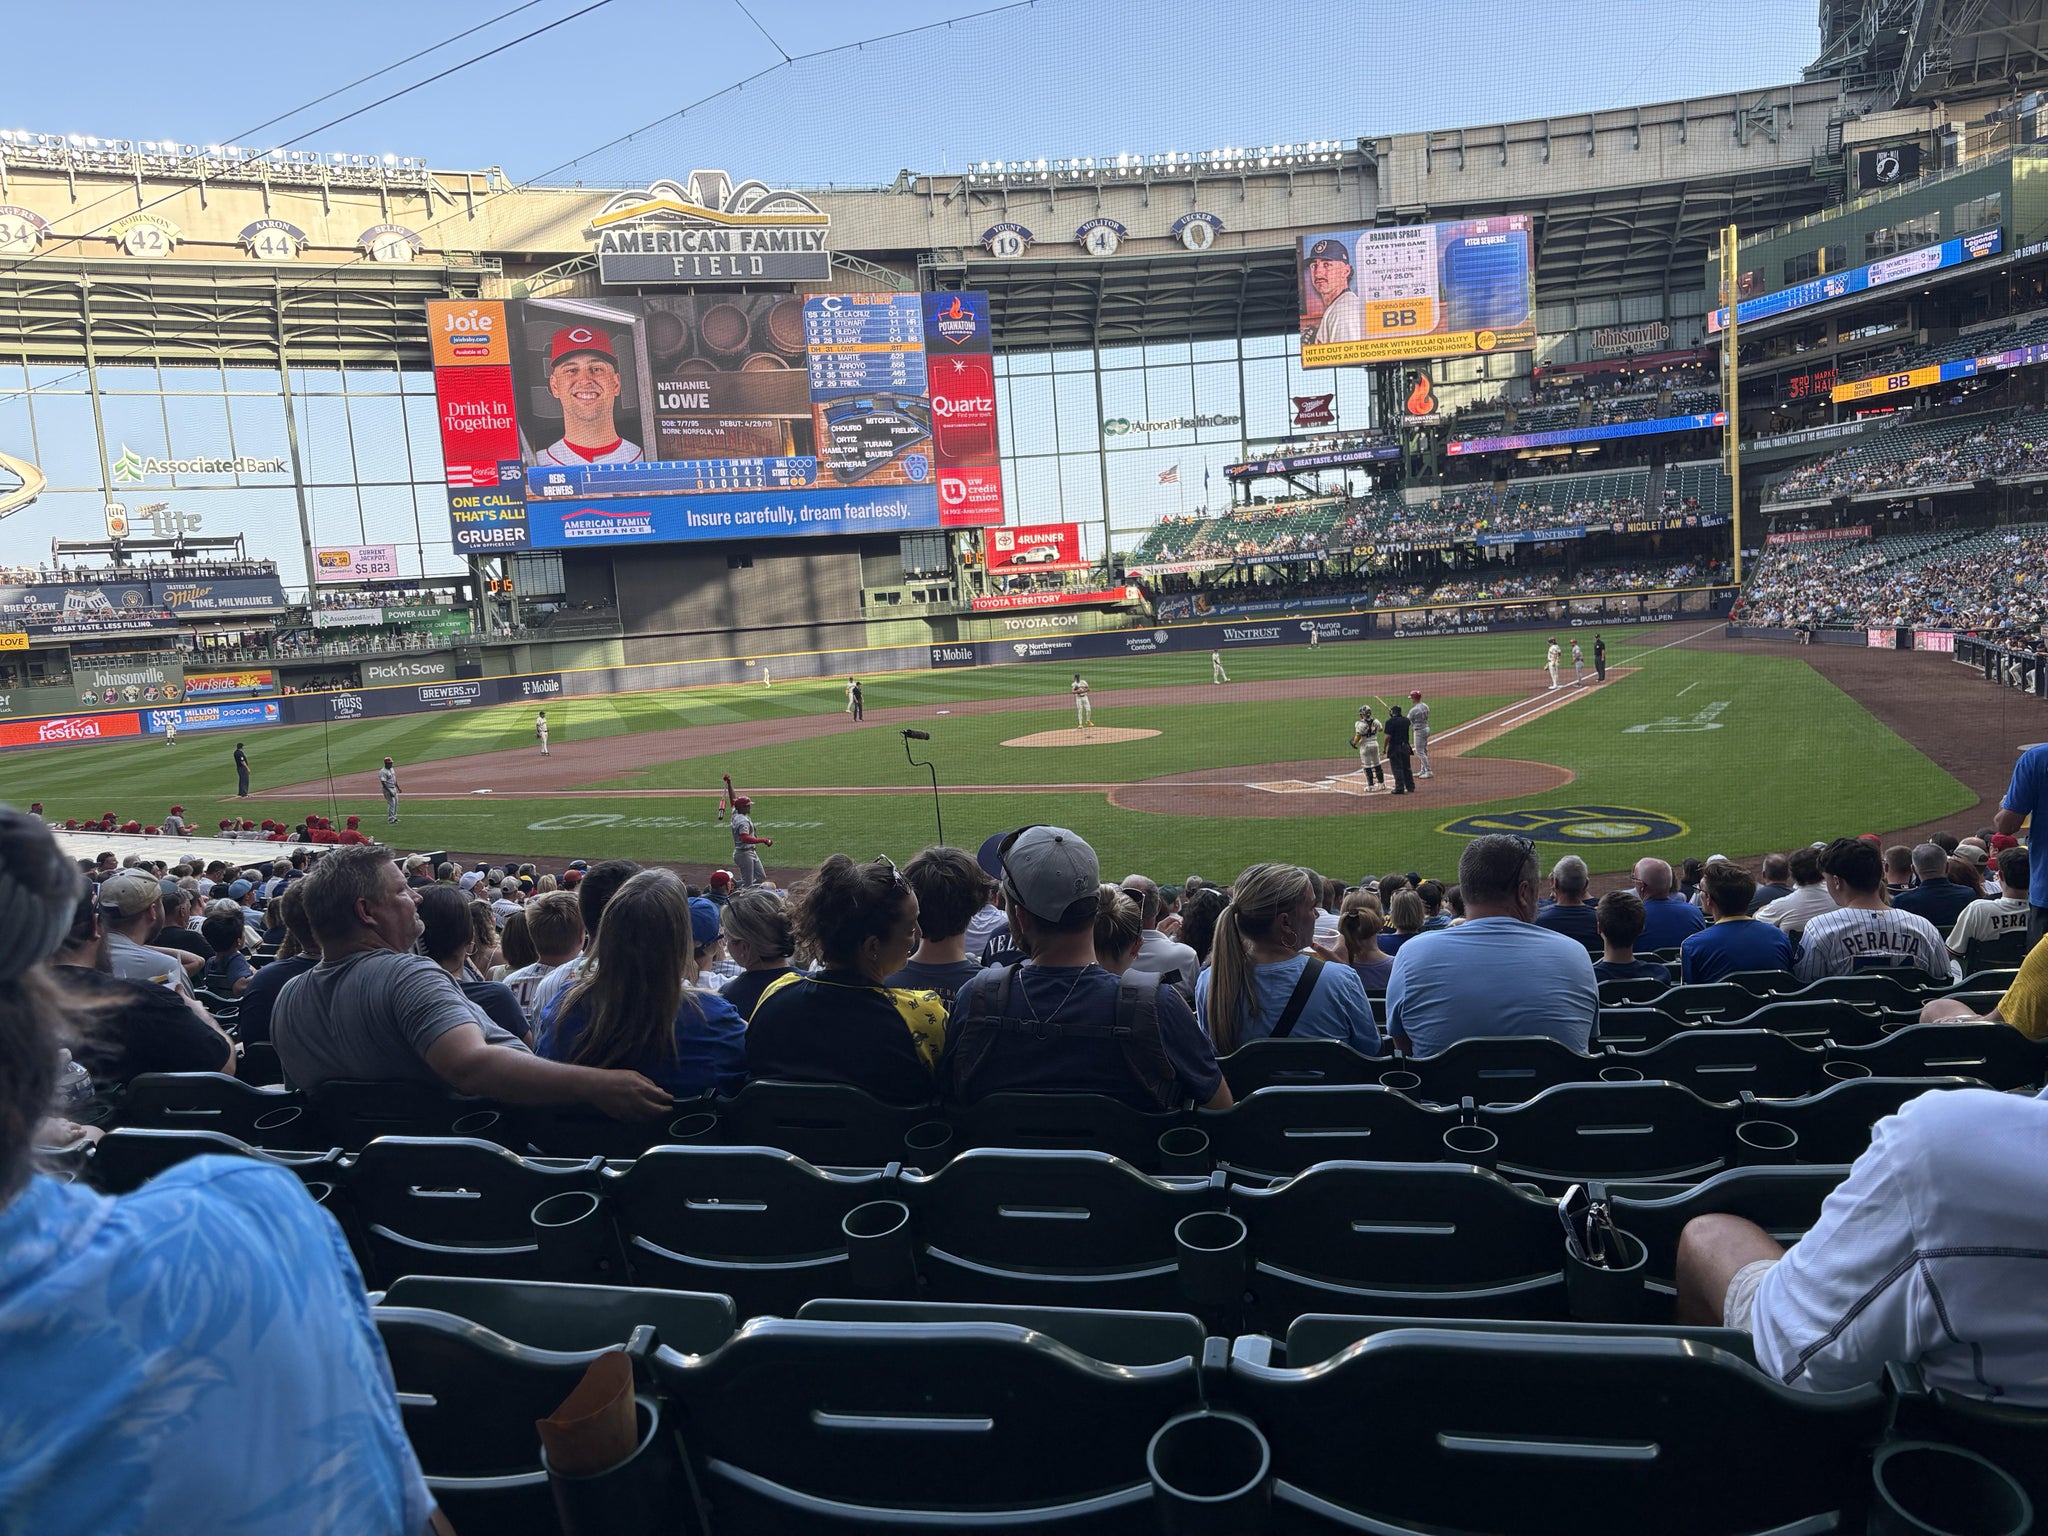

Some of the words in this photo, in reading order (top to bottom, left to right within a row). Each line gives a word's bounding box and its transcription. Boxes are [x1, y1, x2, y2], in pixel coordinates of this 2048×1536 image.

[119, 213, 172, 229] ROBINSON
[1181, 212, 1213, 223] UECKER
[256, 221, 290, 232] AARON
[374, 225, 405, 235] SELIG
[993, 224, 1021, 234] YOUNT
[1082, 219, 1120, 232] MOLITOR
[131, 230, 163, 250] 42
[1095, 232, 1106, 249] 4
[1370, 231, 1397, 241] BRANDON
[1398, 229, 1421, 239] SPROAT
[1464, 238, 1480, 246] PITCH
[1481, 235, 1507, 245] SEQUENCE
[1964, 233, 1998, 248] Legends
[260, 235, 289, 254] 44
[601, 231, 731, 254] AMERICAN
[741, 230, 826, 252] FAMILY
[997, 237, 1019, 254] 19
[1969, 242, 1992, 252] Game
[673, 255, 764, 277] FIELD
[444, 310, 493, 331] Joie
[1382, 309, 1417, 328] BB
[938, 321, 976, 332] POTAWATOMI
[1411, 338, 1436, 346] PELLA!
[1436, 335, 1468, 345] QUALITY
[1592, 322, 1669, 349] Johnsonville
[1305, 354, 1342, 363] WINDOWS
[1360, 351, 1385, 359] DOORS
[1387, 348, 1402, 356] FOR
[1403, 345, 1444, 355] WISCONSIN
[1445, 342, 1474, 351] HOMES.
[1604, 344, 1631, 354] PARTY
[1633, 342, 1656, 350] DECK
[1814, 369, 1839, 380] MARKET
[657, 381, 710, 391] NATHANIEL
[1887, 374, 1910, 390] BB
[659, 393, 710, 409] LOWE
[932, 395, 993, 417] Quartz
[447, 400, 492, 417] Drink
[494, 400, 508, 414] in
[444, 415, 513, 433] Together
[1131, 420, 1170, 434] Aurora
[1173, 416, 1211, 430] Health
[1213, 413, 1241, 426] Care
[836, 436, 857, 444] ORTIZ
[864, 440, 893, 448] TURANG
[865, 450, 893, 458] BAUERS
[1293, 458, 1312, 467] GREAT
[1313, 457, 1333, 465] TASTE.
[1333, 455, 1342, 463] 96
[1342, 452, 1374, 461] CALORIES.
[825, 460, 867, 468] CONTRERAS
[501, 471, 522, 481] 250
[549, 473, 566, 484] REDS
[543, 485, 574, 496] BREWERS
[968, 484, 997, 494] credit
[452, 496, 480, 508] ONE
[482, 495, 523, 506] CALL...
[969, 493, 998, 502] union
[107, 508, 125, 517] Lite
[452, 510, 497, 522] THAT'S
[499, 508, 526, 520] ALL!
[687, 509, 731, 527] Insure
[734, 505, 797, 526] carefully,
[800, 505, 842, 523] dream
[844, 501, 911, 521] fearlessly.
[152, 511, 202, 538] Lite
[564, 519, 614, 530] AMERICAN
[617, 517, 651, 527] FAMILY
[1627, 520, 1662, 532] NICOLET
[1665, 518, 1683, 529] LAW
[457, 527, 526, 543] GRUBER
[571, 527, 645, 536] INSURANCE
[1533, 528, 1580, 539] WINTRUST
[1017, 532, 1064, 545] 4RUNNER
[1353, 545, 1375, 556] 620
[1376, 542, 1412, 554] WTMJ
[1413, 543, 1450, 551] BREWERS
[1247, 556, 1264, 564] GREAT
[1289, 552, 1317, 560] CALORIES.
[24, 595, 37, 604] GO
[163, 586, 213, 608] Miller
[191, 598, 218, 609] TIME,
[218, 595, 273, 607] MILWAUKEE
[975, 598, 1010, 609] TOYOTA
[1011, 594, 1061, 606] TERRITORY
[3, 604, 29, 613] BREW
[31, 603, 55, 611] CREW
[388, 609, 416, 619] POWER
[417, 608, 441, 617] ALLEY
[52, 624, 76, 632] GREAT
[77, 623, 103, 631] TASTE.
[103, 622, 121, 630] LESS
[122, 620, 153, 629] FILLING.
[1004, 615, 1079, 630] TOYOTA.COM
[1316, 621, 1341, 630] Aurora
[1583, 618, 1602, 626] Aurora
[1640, 614, 1673, 622] BULLPEN
[1223, 627, 1279, 639] WINTRUST
[1317, 628, 1341, 637] Health
[1342, 628, 1359, 636] Care
[1457, 626, 1488, 634] BULLPEN
[0, 637, 24, 646] LOVE
[1028, 641, 1072, 650] Northwestern
[1126, 637, 1151, 646] Johnson
[1130, 643, 1156, 651] Controls
[942, 648, 973, 661] Mobile
[1029, 648, 1052, 656] Mutual
[368, 665, 398, 679] Pick
[411, 663, 445, 676] Save
[93, 668, 165, 688] Johnsonville
[186, 677, 235, 693] Surfside
[531, 680, 559, 694] Mobile
[423, 686, 477, 699] BREWERS.TV
[330, 696, 363, 711] TRUSS
[184, 707, 219, 717] MILLION
[185, 714, 220, 723] JACKPOT
[38, 720, 101, 741] festival
[1990, 914, 2027, 929] PERA
[1842, 931, 1920, 955] PERALTA
